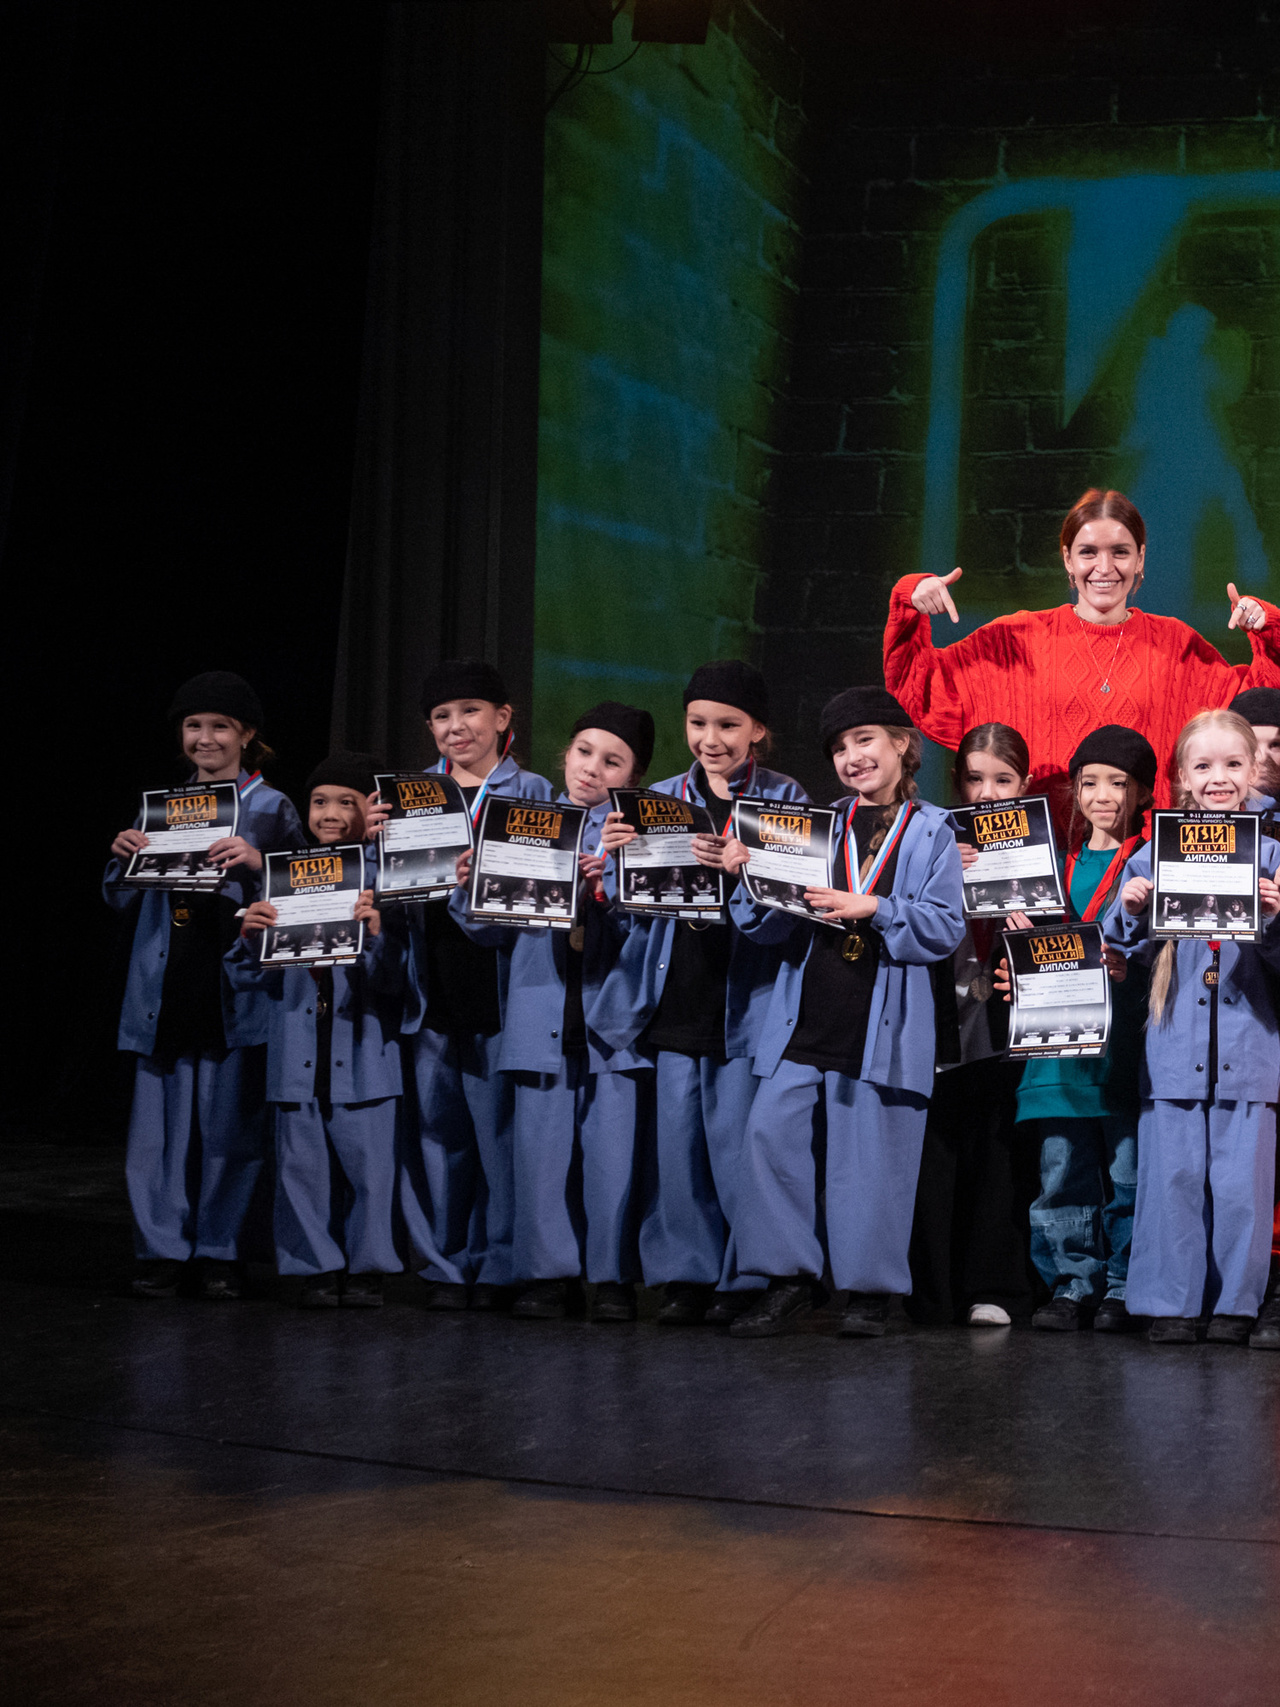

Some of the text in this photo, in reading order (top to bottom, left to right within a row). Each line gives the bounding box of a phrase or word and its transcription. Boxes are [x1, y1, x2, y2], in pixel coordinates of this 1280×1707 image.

[406, 806, 443, 817] ДИПЛОМ
[169, 822, 209, 830] ДИПЛОМ
[976, 812, 1020, 834] ИДИ
[647, 826, 688, 834] ДИПЛОМ
[1182, 826, 1228, 844] ИДИ
[508, 835, 550, 847] ДИПЛОМ
[982, 838, 1024, 852] ДИПЛОМ
[764, 843, 804, 855] ДИПЛОМ
[1184, 854, 1228, 862] ДИПЛОМ
[294, 884, 335, 894] ДИПЛОМ
[1039, 961, 1079, 972] ДИПЛОМ
